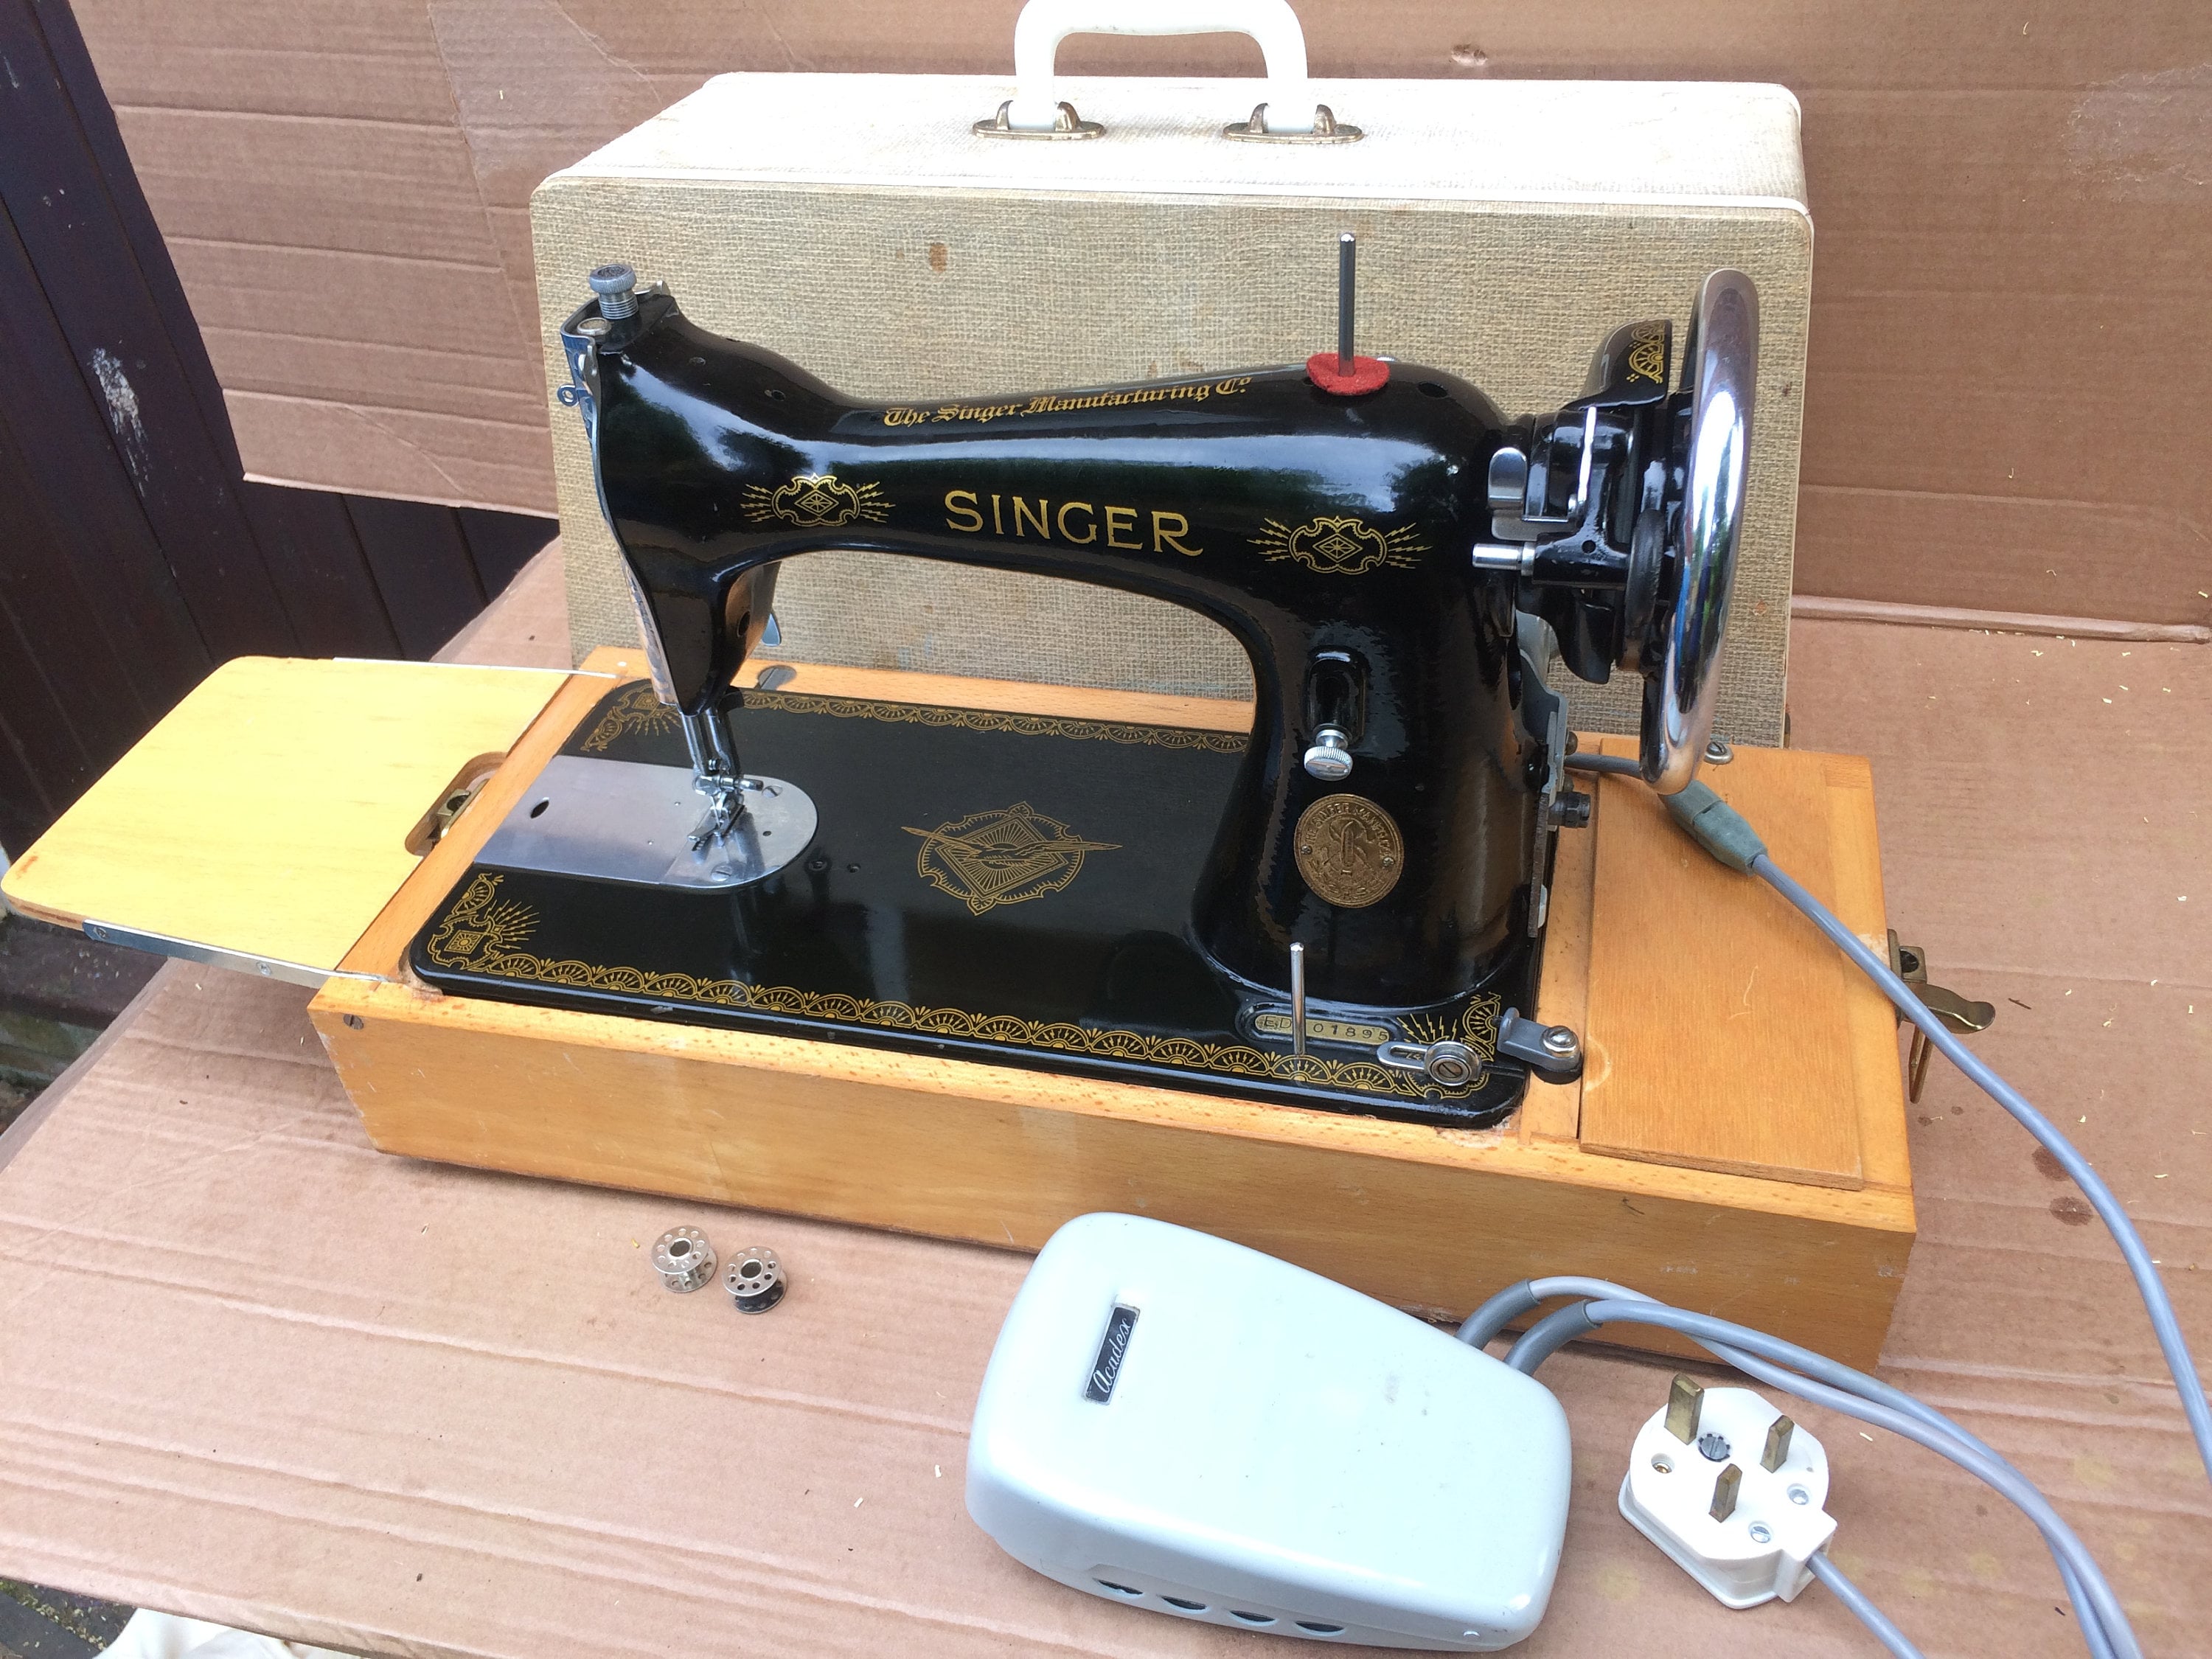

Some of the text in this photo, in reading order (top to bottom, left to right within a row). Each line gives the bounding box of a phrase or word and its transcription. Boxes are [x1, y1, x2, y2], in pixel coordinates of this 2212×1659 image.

[883, 406, 930, 428] The
[931, 403, 1023, 424] Singer
[1020, 386, 1210, 418] Manufacturing
[945, 489, 1204, 557] SINGER
[1092, 1317, 1132, 1394] Acadex
